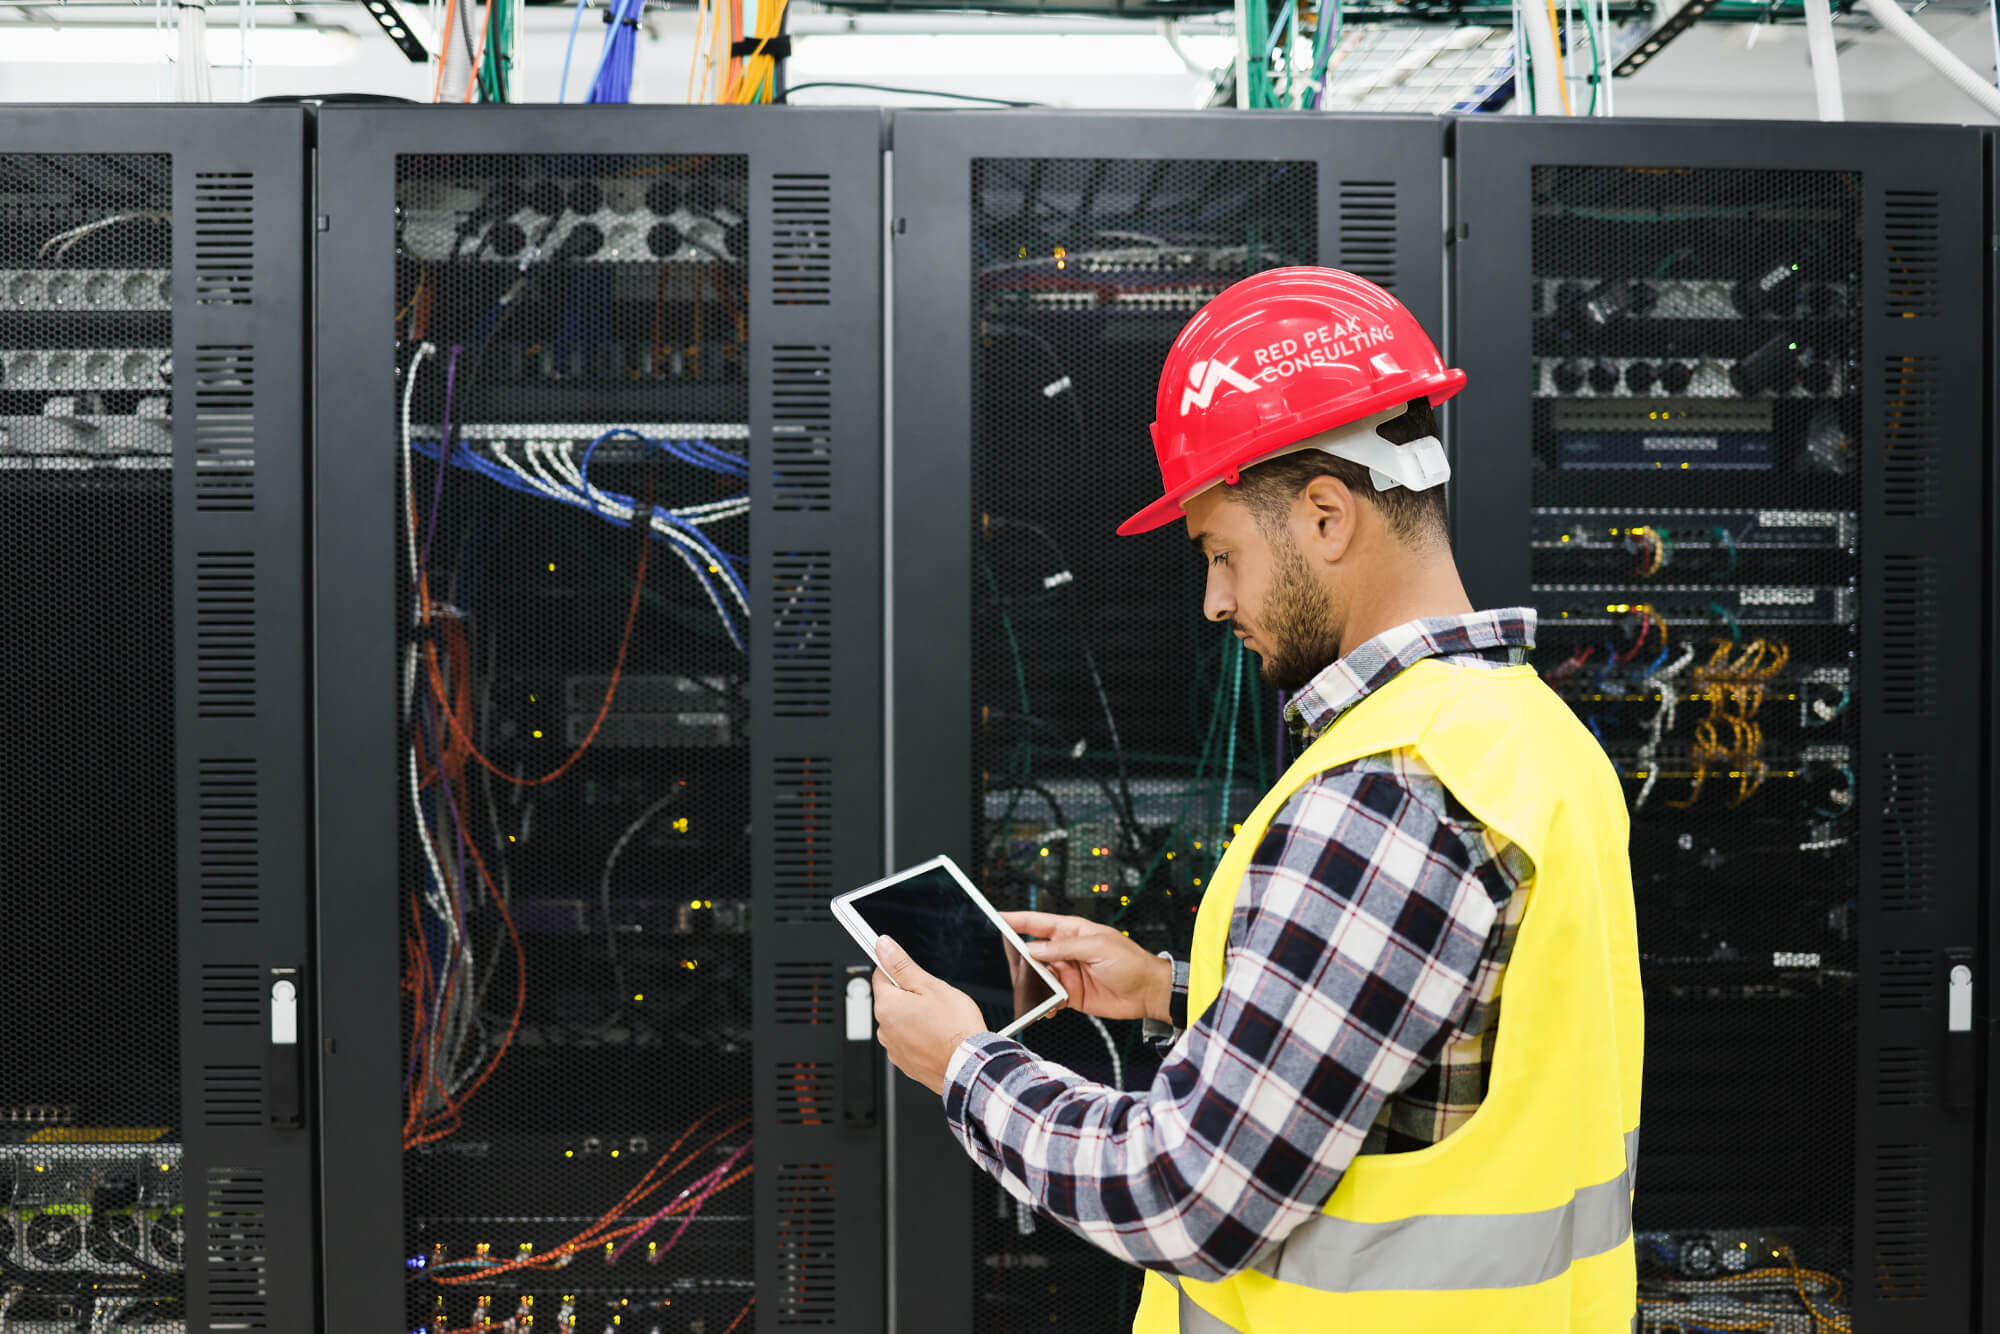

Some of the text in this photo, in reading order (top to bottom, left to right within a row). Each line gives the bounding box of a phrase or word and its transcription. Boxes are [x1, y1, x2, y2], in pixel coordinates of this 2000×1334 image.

[1254, 316, 1361, 366] RED PEAK
[1261, 325, 1394, 383] CONSULTING
